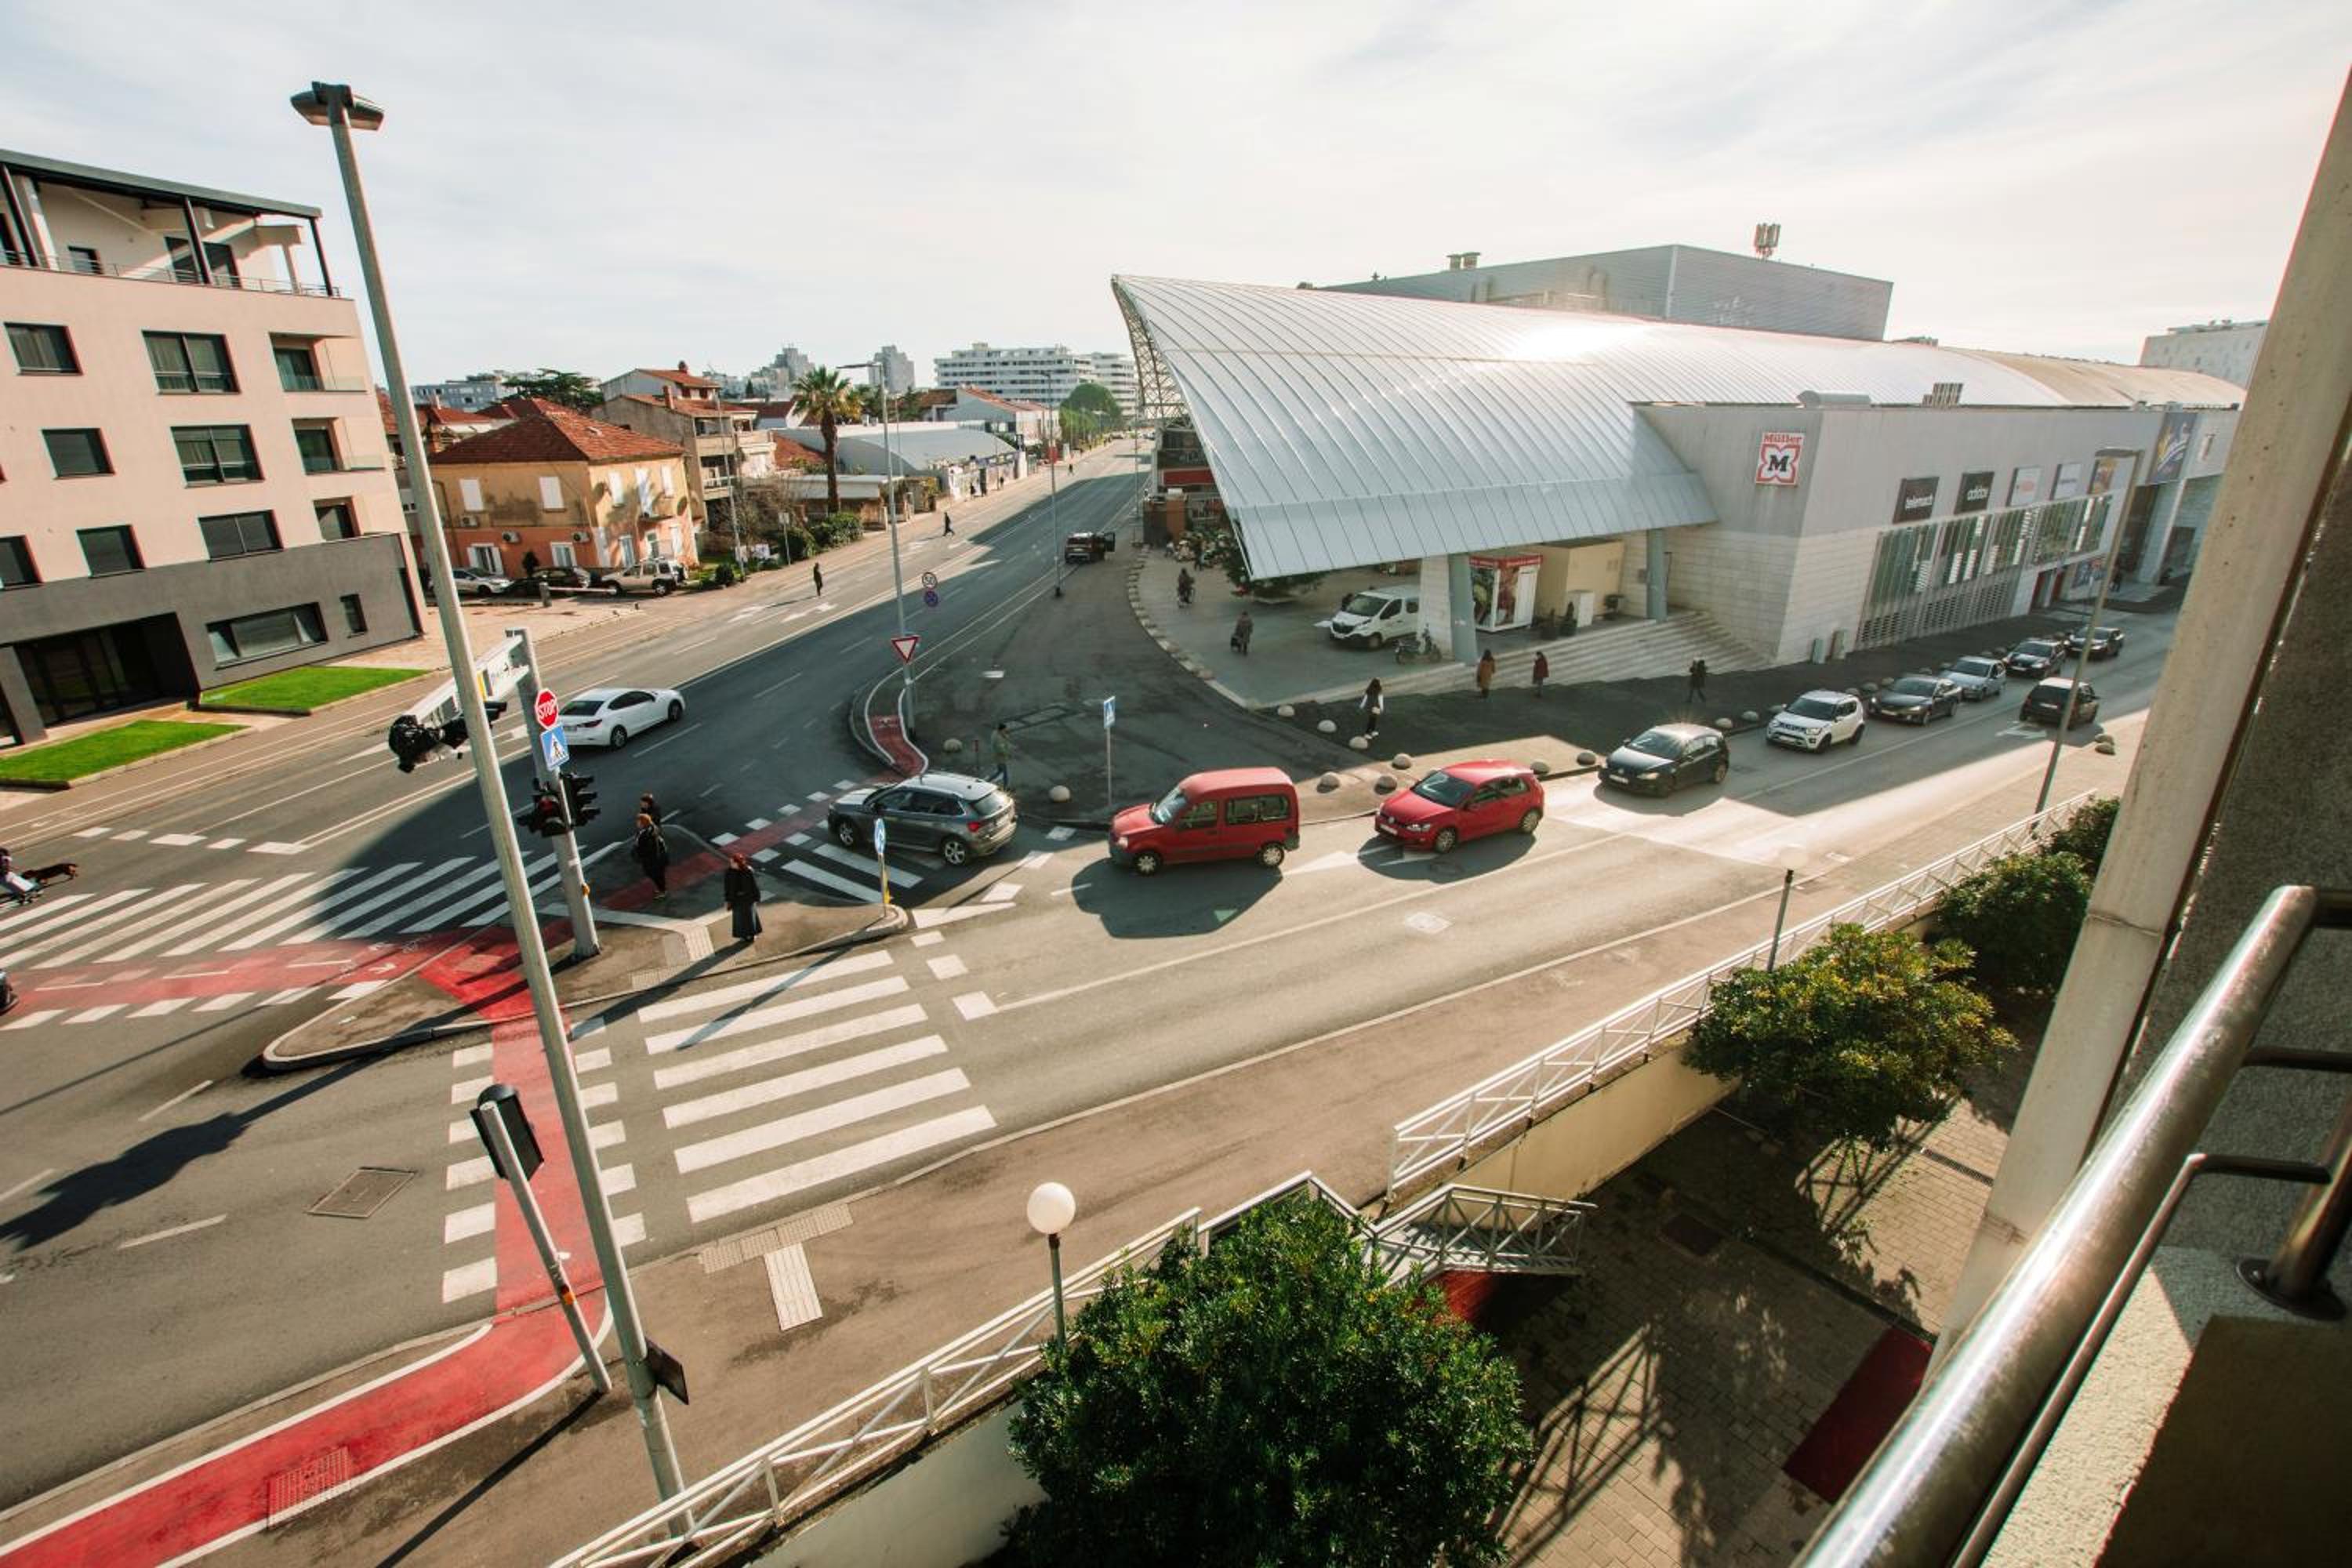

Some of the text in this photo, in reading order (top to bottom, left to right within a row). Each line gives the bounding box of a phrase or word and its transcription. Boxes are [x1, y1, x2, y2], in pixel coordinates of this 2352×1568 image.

[1763, 434, 1802, 444] Müller
[1768, 455, 1789, 471] M
[538, 699, 554, 720] STOP
